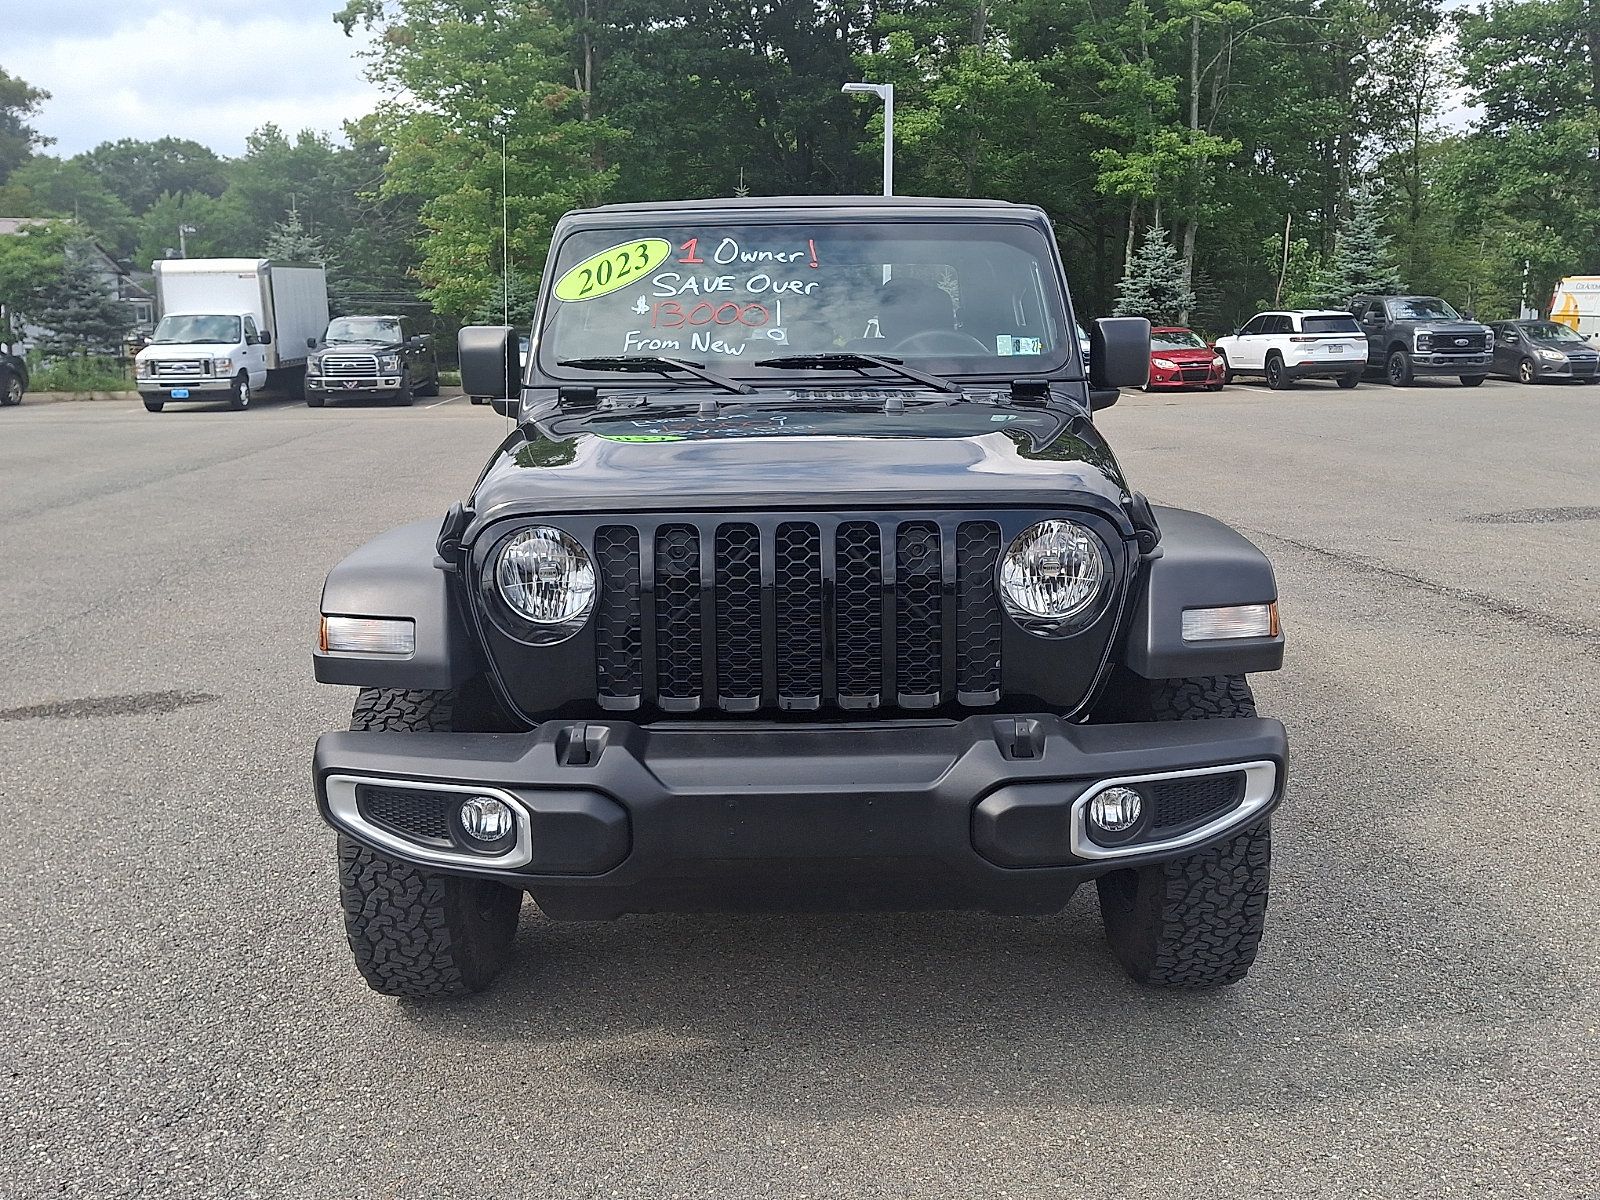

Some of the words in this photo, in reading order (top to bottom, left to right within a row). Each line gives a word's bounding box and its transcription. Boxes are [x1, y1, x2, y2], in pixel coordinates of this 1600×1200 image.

[677, 238, 704, 264] 1
[714, 237, 819, 269] Owner!
[577, 243, 650, 297] 2023
[652, 272, 736, 297] SAVE
[746, 274, 819, 296] Over
[623, 330, 680, 353] From
[691, 331, 746, 356] New
